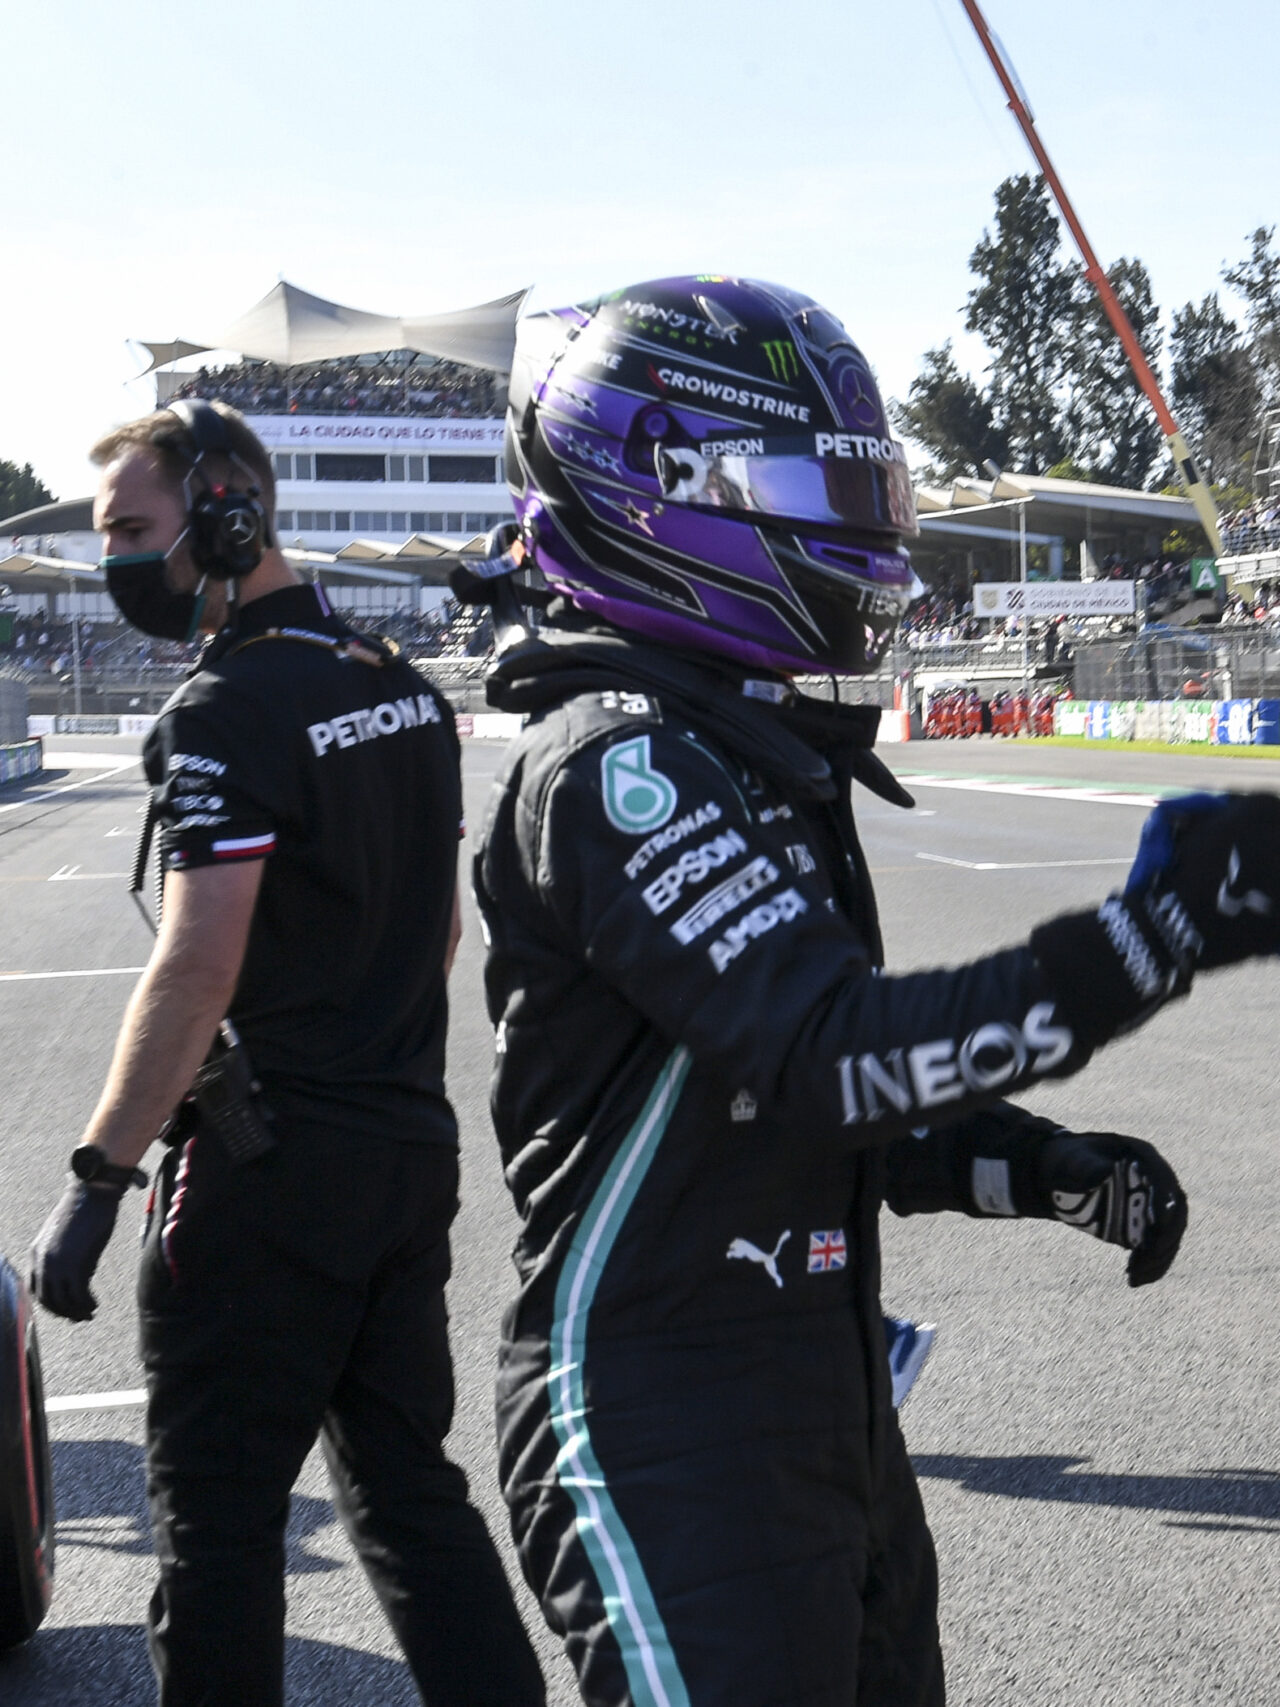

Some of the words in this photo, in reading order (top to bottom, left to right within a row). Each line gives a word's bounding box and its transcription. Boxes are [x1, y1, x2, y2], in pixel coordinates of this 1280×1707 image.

[656, 367, 811, 423] CROWDSTRIKE
[289, 425, 312, 437] LA
[700, 439, 764, 457] EPSON
[815, 432, 904, 462] PETRON
[307, 693, 441, 757] PETRONA
[624, 801, 722, 880] PETRONAS
[641, 828, 748, 916] EPSON
[836, 1003, 1072, 1125] INEOS
